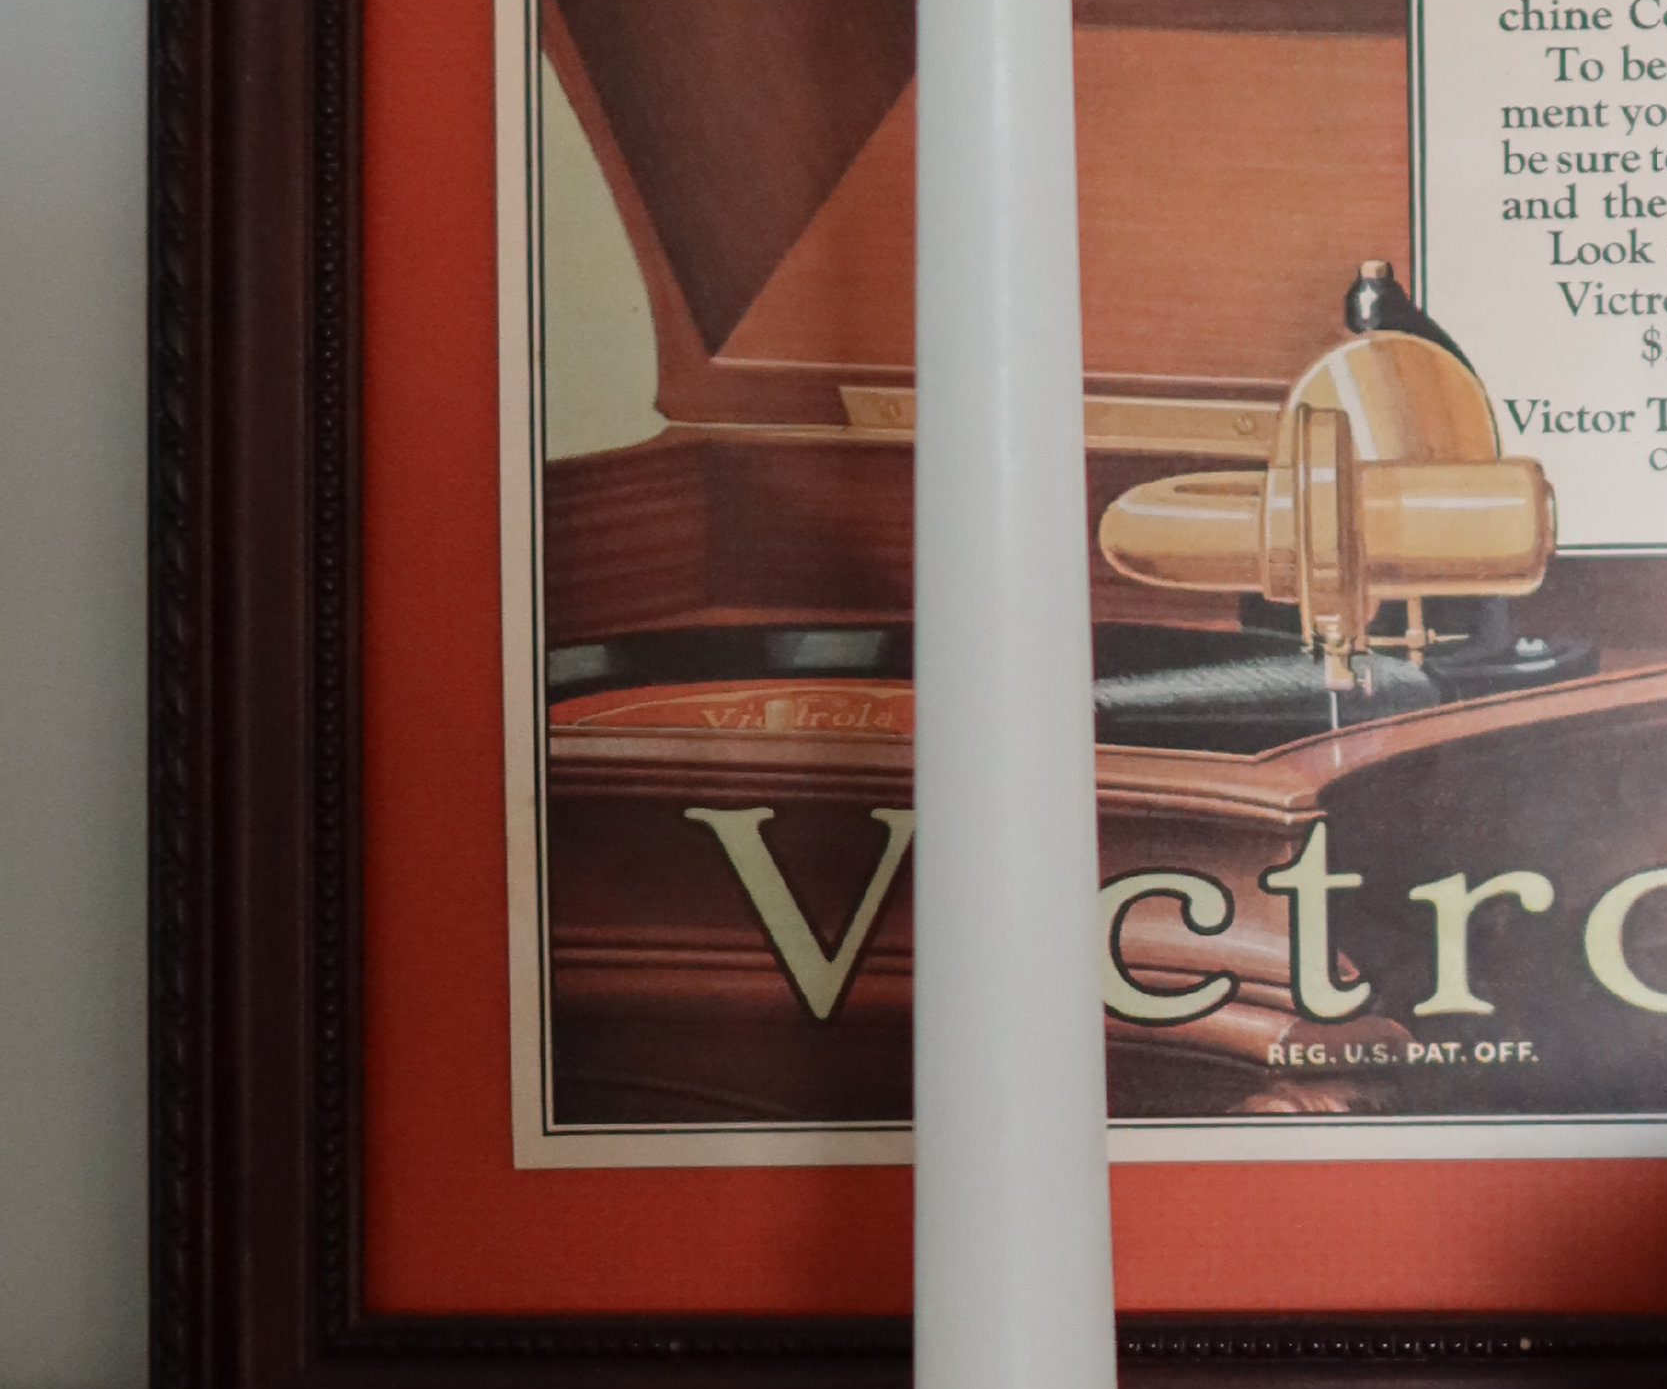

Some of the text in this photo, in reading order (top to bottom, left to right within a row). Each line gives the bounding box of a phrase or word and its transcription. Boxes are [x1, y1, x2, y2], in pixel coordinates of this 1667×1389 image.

[1545, 46, 1605, 83] To
[1620, 44, 1667, 82] be
[1500, 99, 1610, 129] ment
[1501, 138, 1549, 175] be
[1556, 150, 1641, 175] sure
[1501, 182, 1579, 221] and
[1602, 181, 1667, 220] the
[1547, 227, 1656, 266] Look
[1502, 398, 1636, 435] Victor
[1267, 1041, 1540, 1067] REG. U.S. PAT. OFF.
